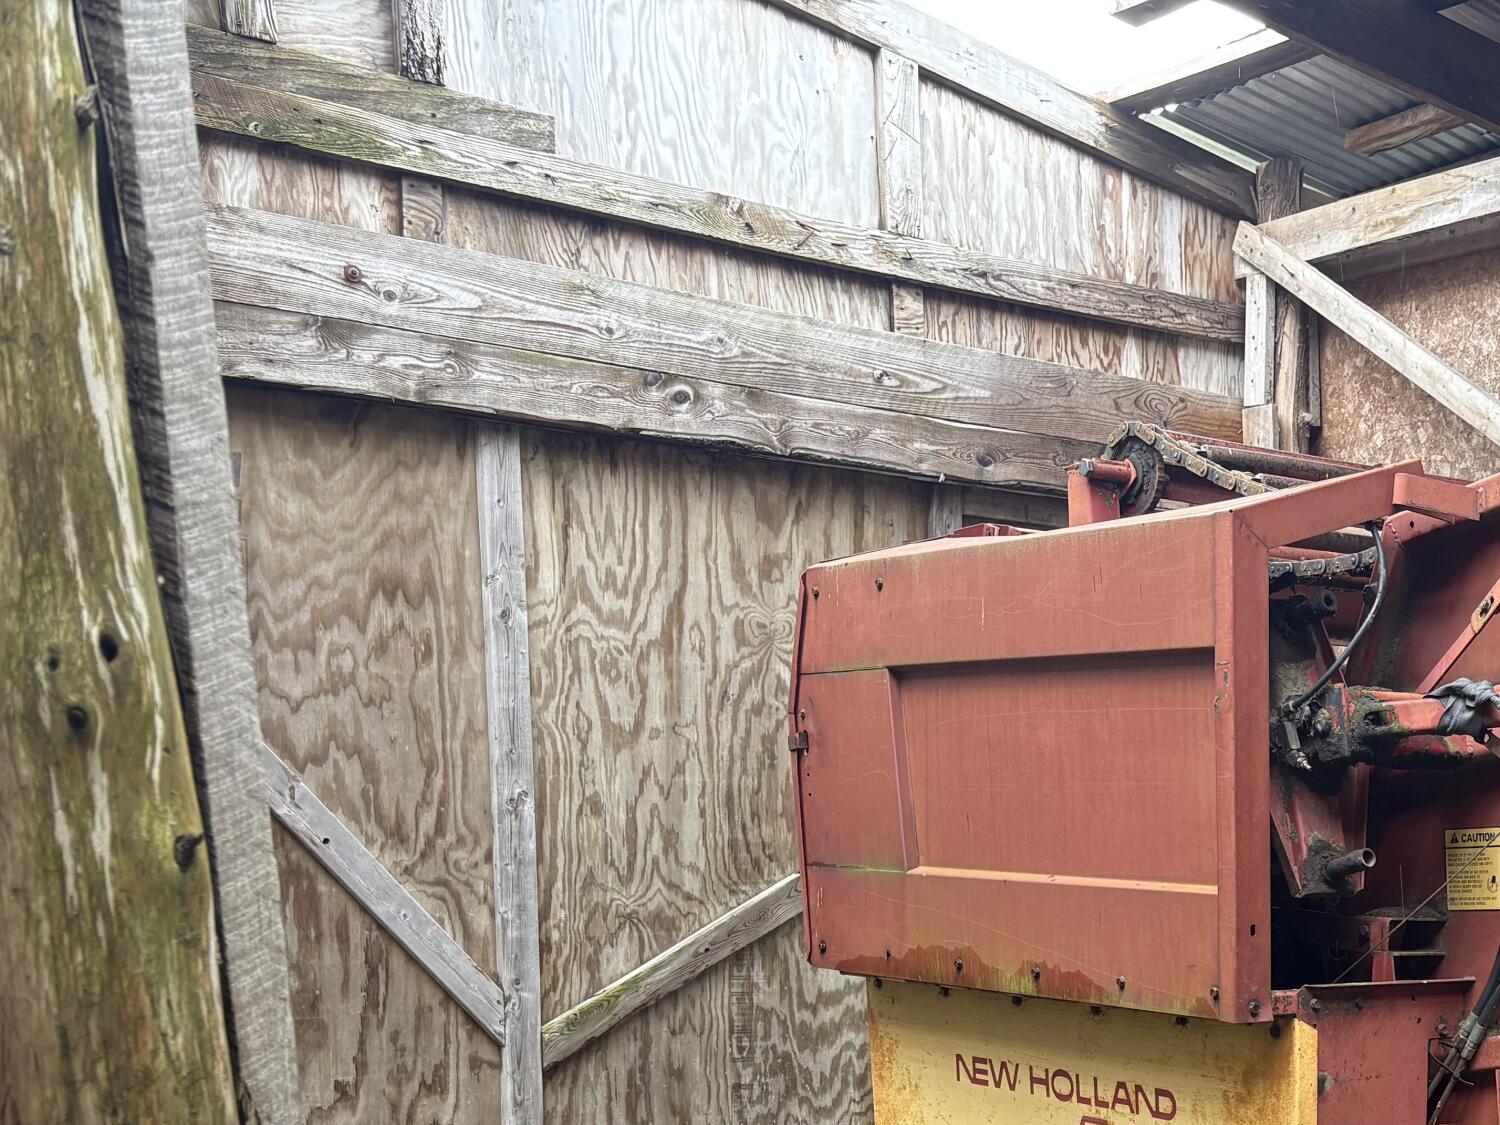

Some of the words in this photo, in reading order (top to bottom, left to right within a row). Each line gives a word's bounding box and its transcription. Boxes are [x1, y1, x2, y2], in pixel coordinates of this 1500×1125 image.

[1461, 833, 1496, 843] CAUTION
[955, 1053, 1020, 1092] NEW
[1029, 1065, 1177, 1121] HOLLAND
